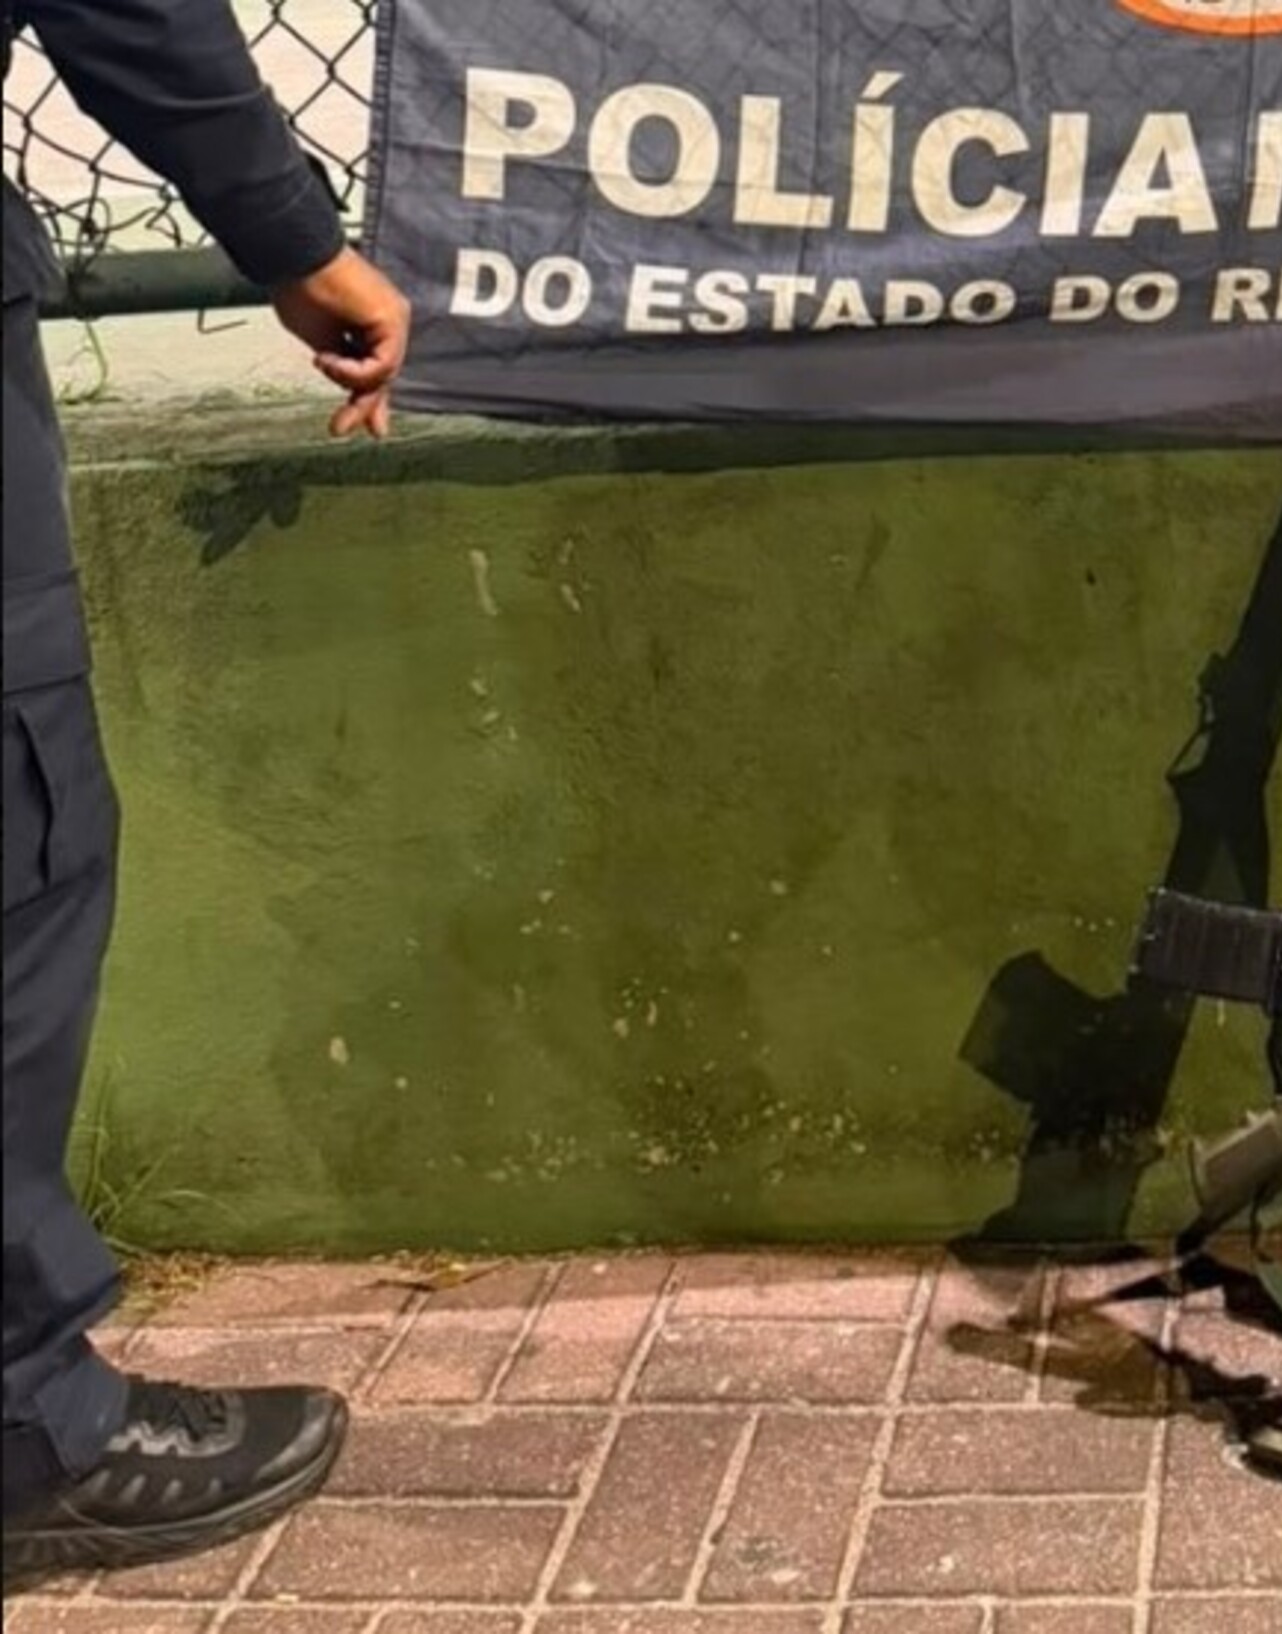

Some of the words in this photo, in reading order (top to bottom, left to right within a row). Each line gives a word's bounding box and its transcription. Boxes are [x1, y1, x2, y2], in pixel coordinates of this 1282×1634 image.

[460, 67, 1219, 238] POLÍCIA
[450, 248, 592, 328] DO
[624, 264, 1016, 334] ESTADO
[1049, 271, 1180, 325] DO
